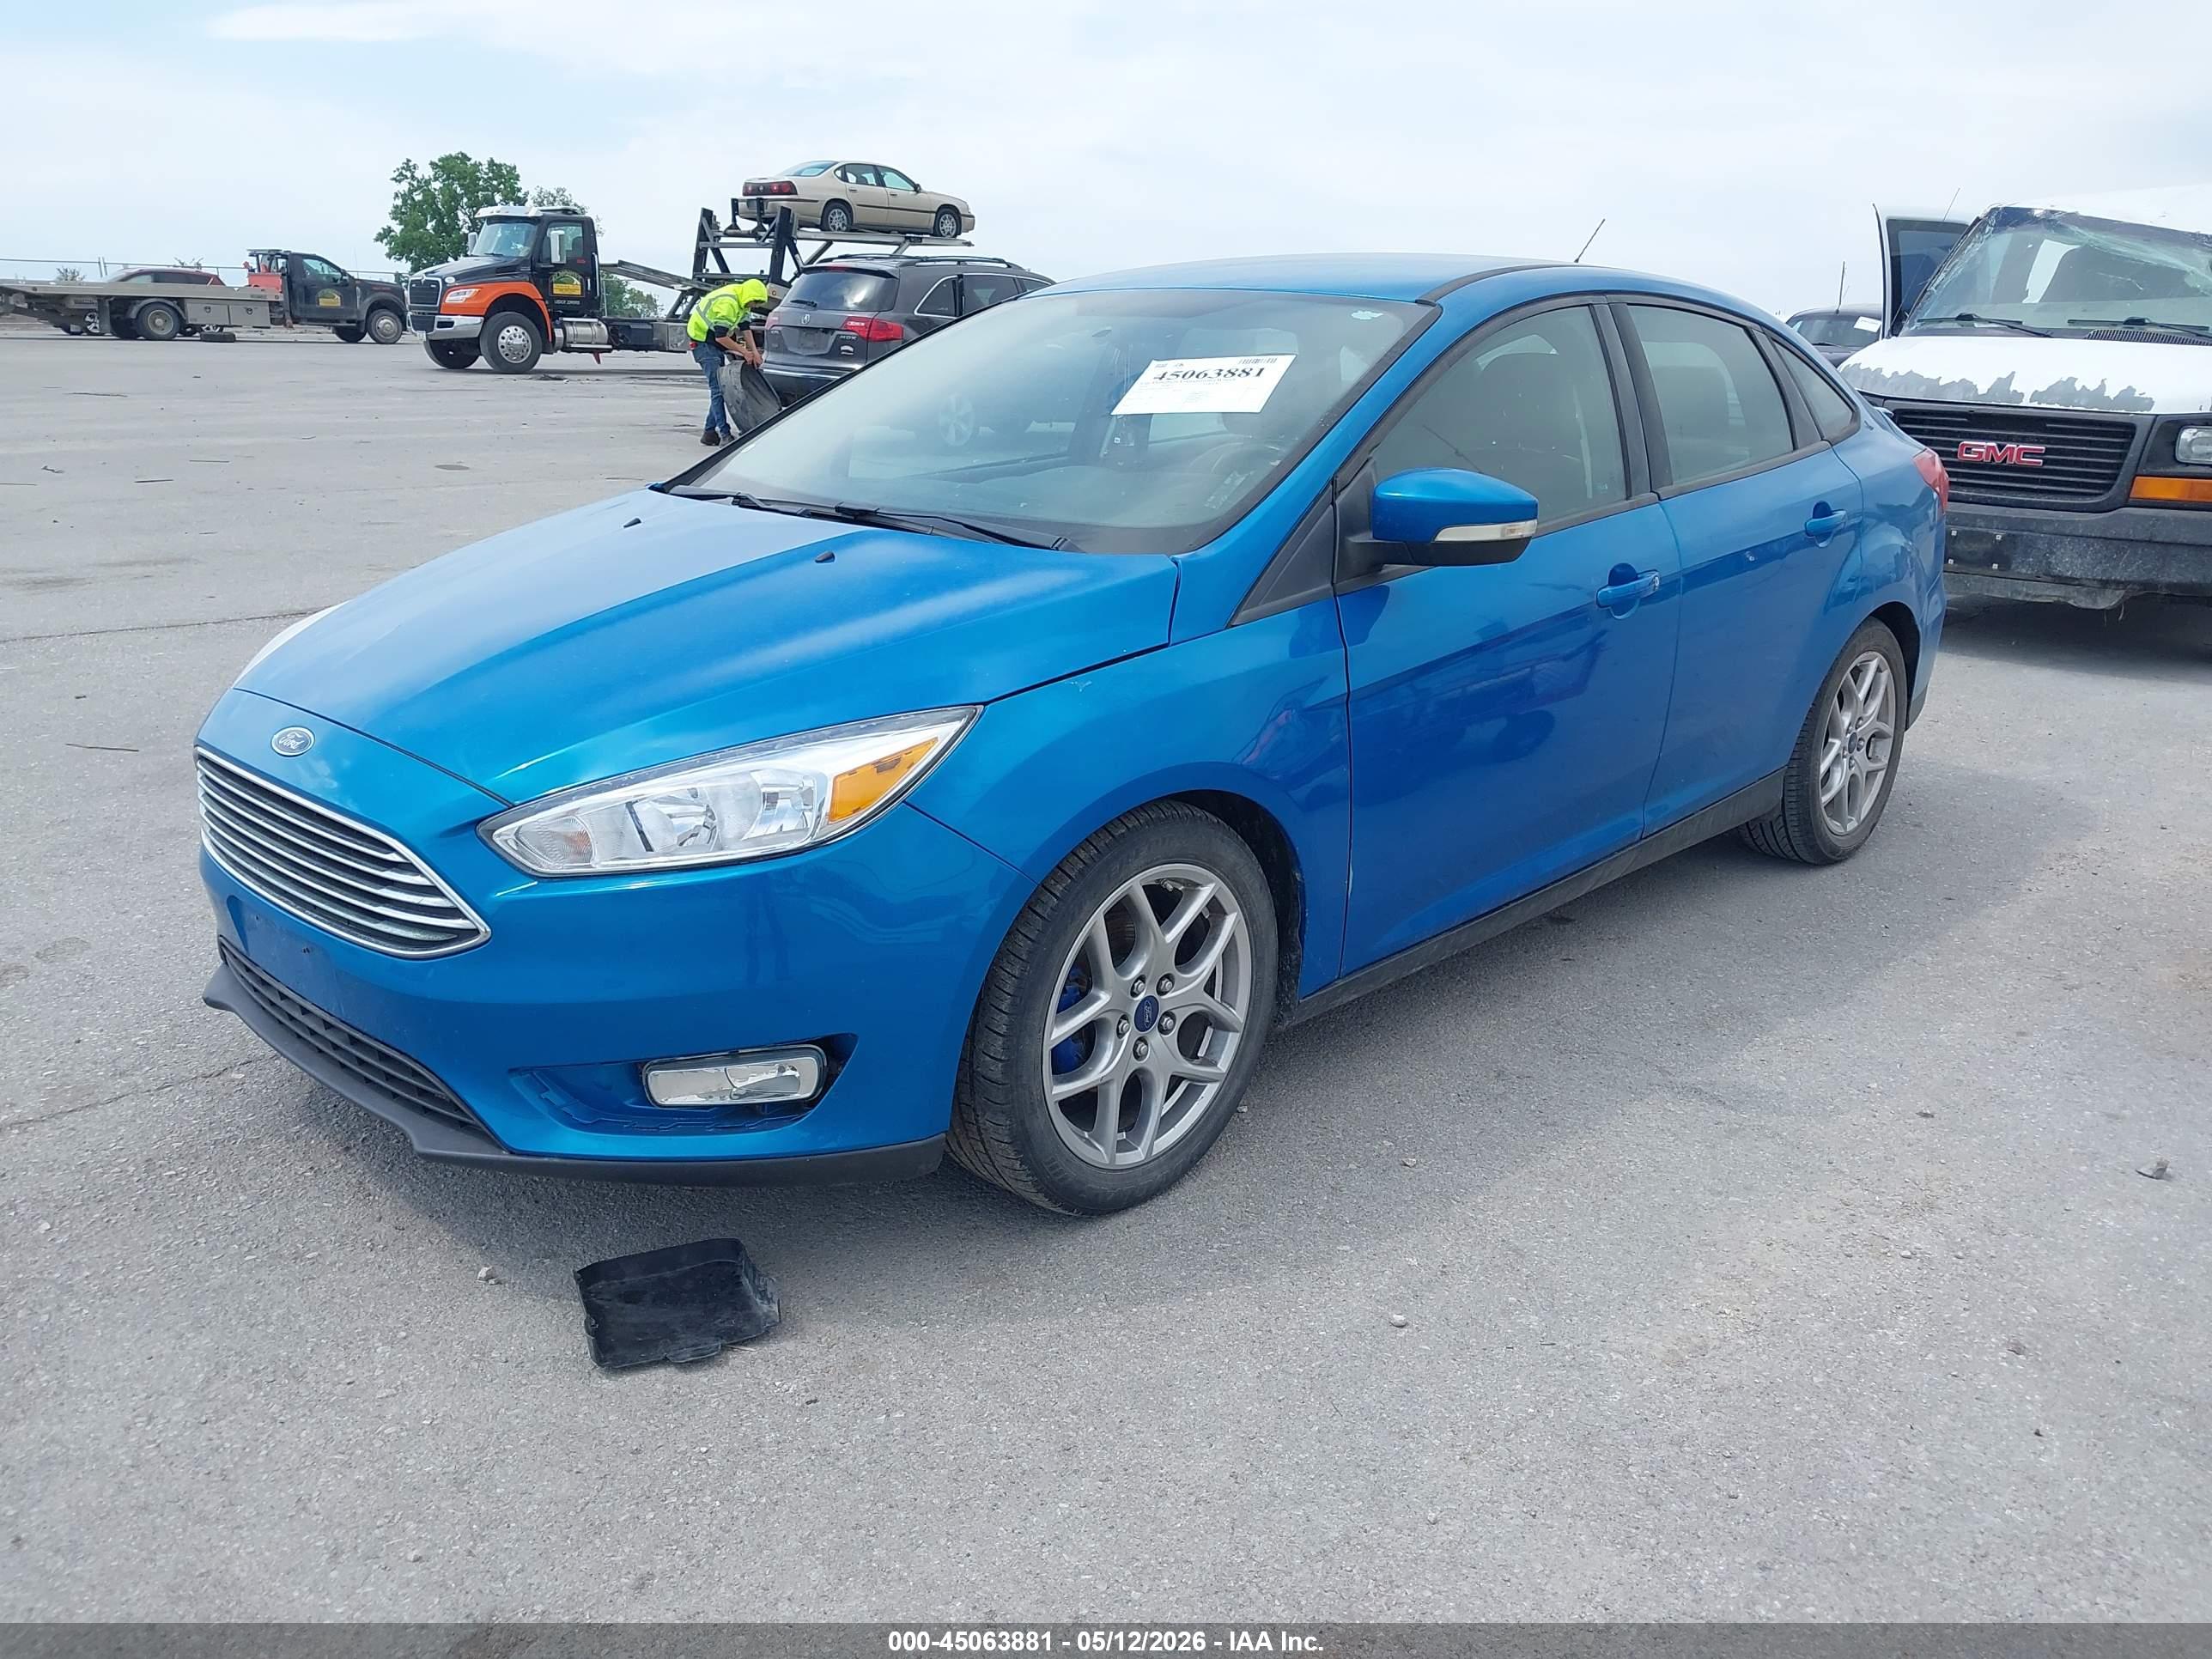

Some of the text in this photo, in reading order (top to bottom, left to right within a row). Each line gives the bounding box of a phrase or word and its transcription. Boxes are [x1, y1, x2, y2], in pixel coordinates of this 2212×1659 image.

[1153, 368, 1265, 380] 45063881
[1957, 441, 2046, 466] GMC
[278, 732, 305, 750] Ford
